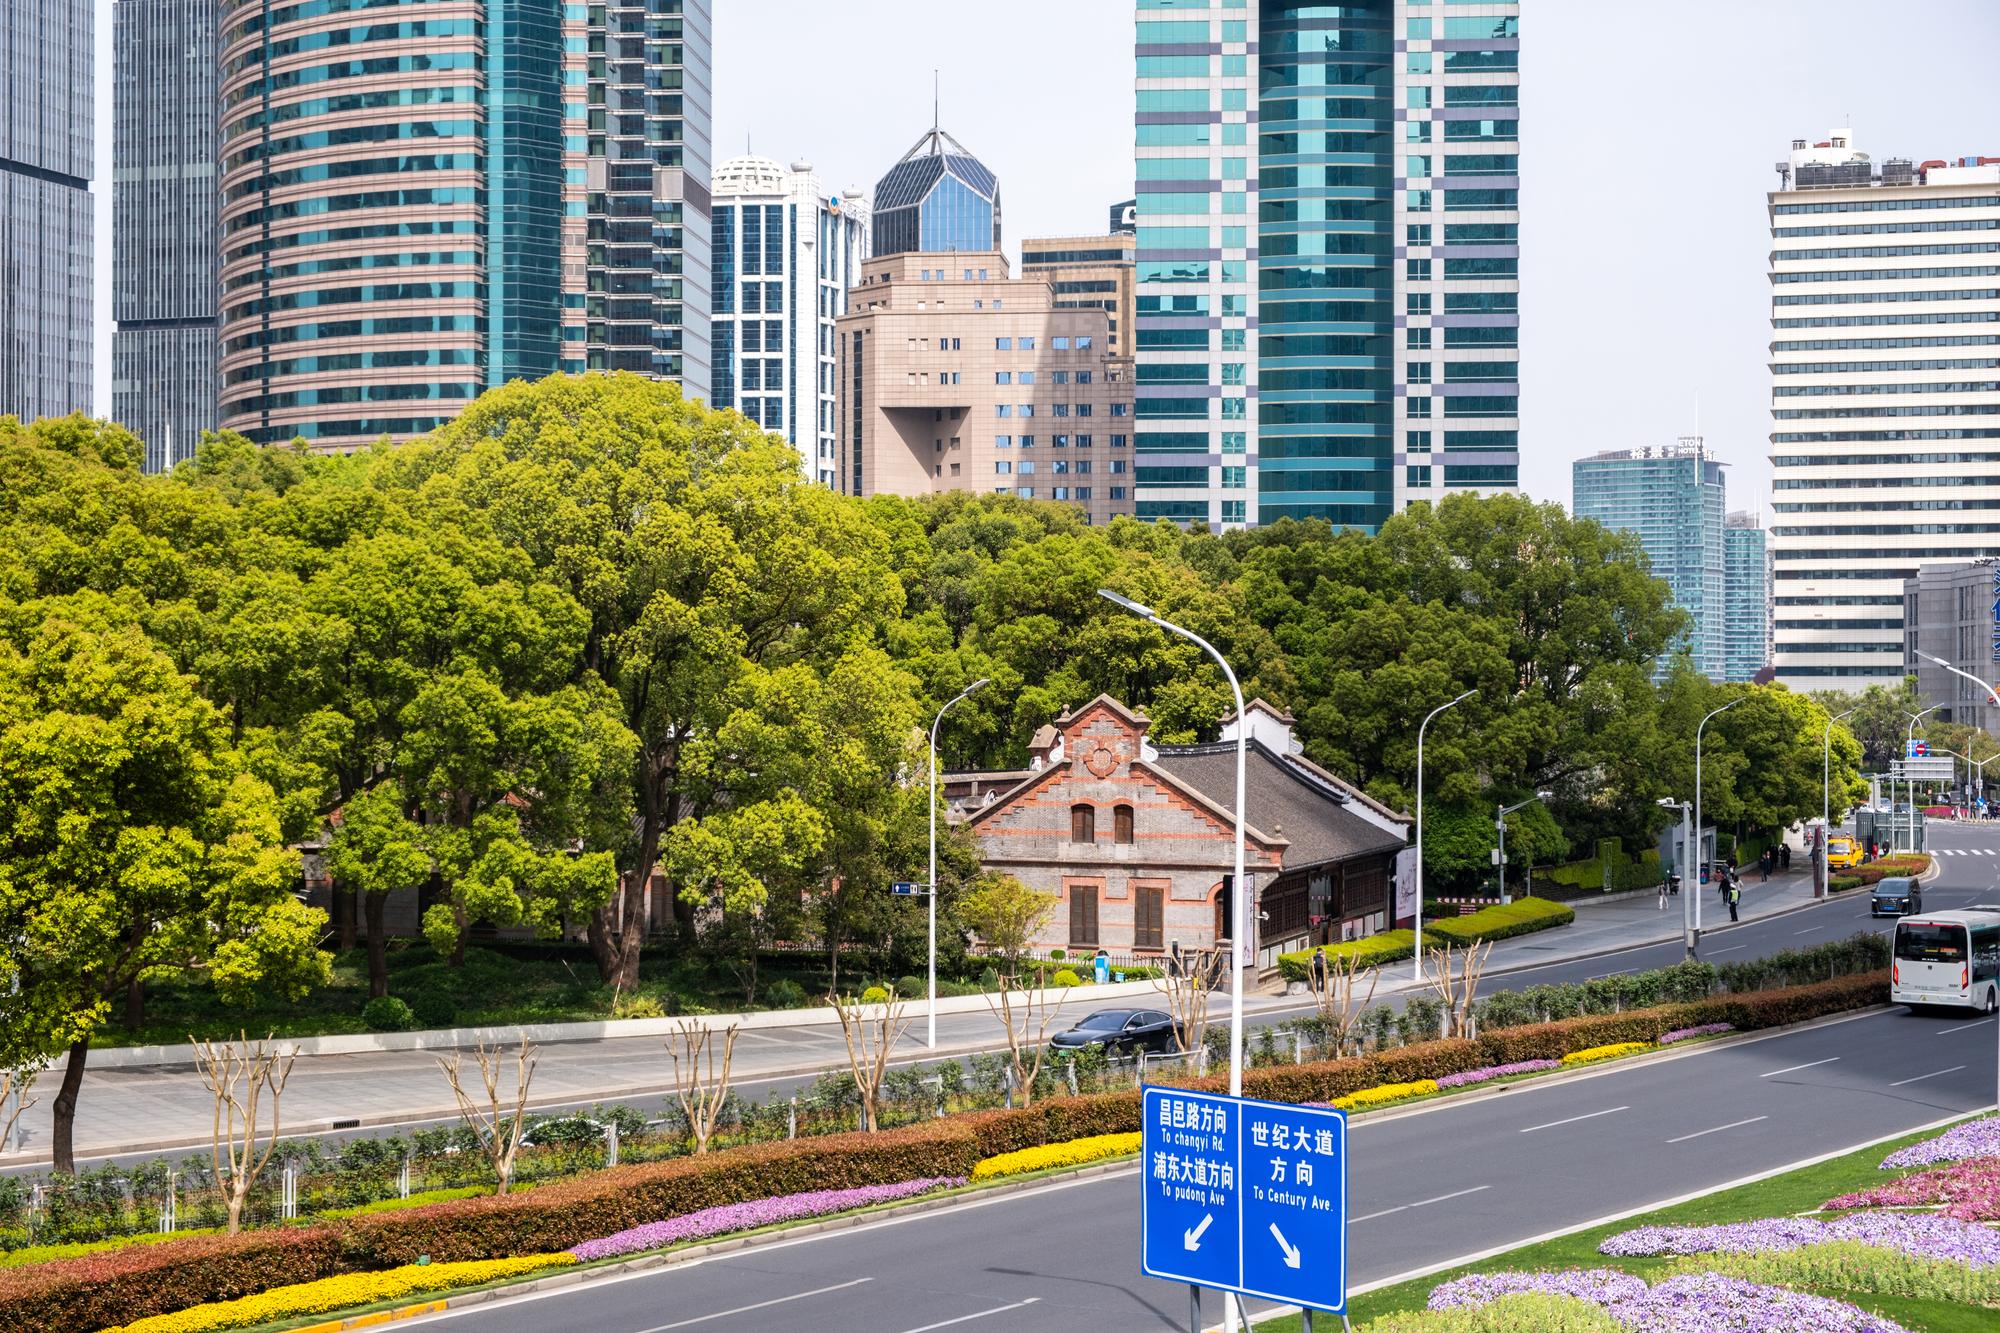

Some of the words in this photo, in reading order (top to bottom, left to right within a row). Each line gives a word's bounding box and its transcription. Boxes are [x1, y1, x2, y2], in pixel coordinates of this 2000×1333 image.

[1159, 1098, 1227, 1134] 昌邑路方向
[1161, 1127, 1171, 1144] To
[1174, 1132, 1209, 1152] changyi
[1212, 1136, 1225, 1152] Rd.
[1251, 1121, 1334, 1156] 世纪大道
[1153, 1151, 1234, 1191] 浦东大道方向
[1270, 1156, 1313, 1187] 方向
[1161, 1181, 1171, 1197] To
[1175, 1186, 1206, 1207] pudong
[1209, 1190, 1225, 1206] Ave
[1253, 1185, 1264, 1200] To
[1268, 1187, 1307, 1210] Century
[1311, 1195, 1334, 1212] Ave.
